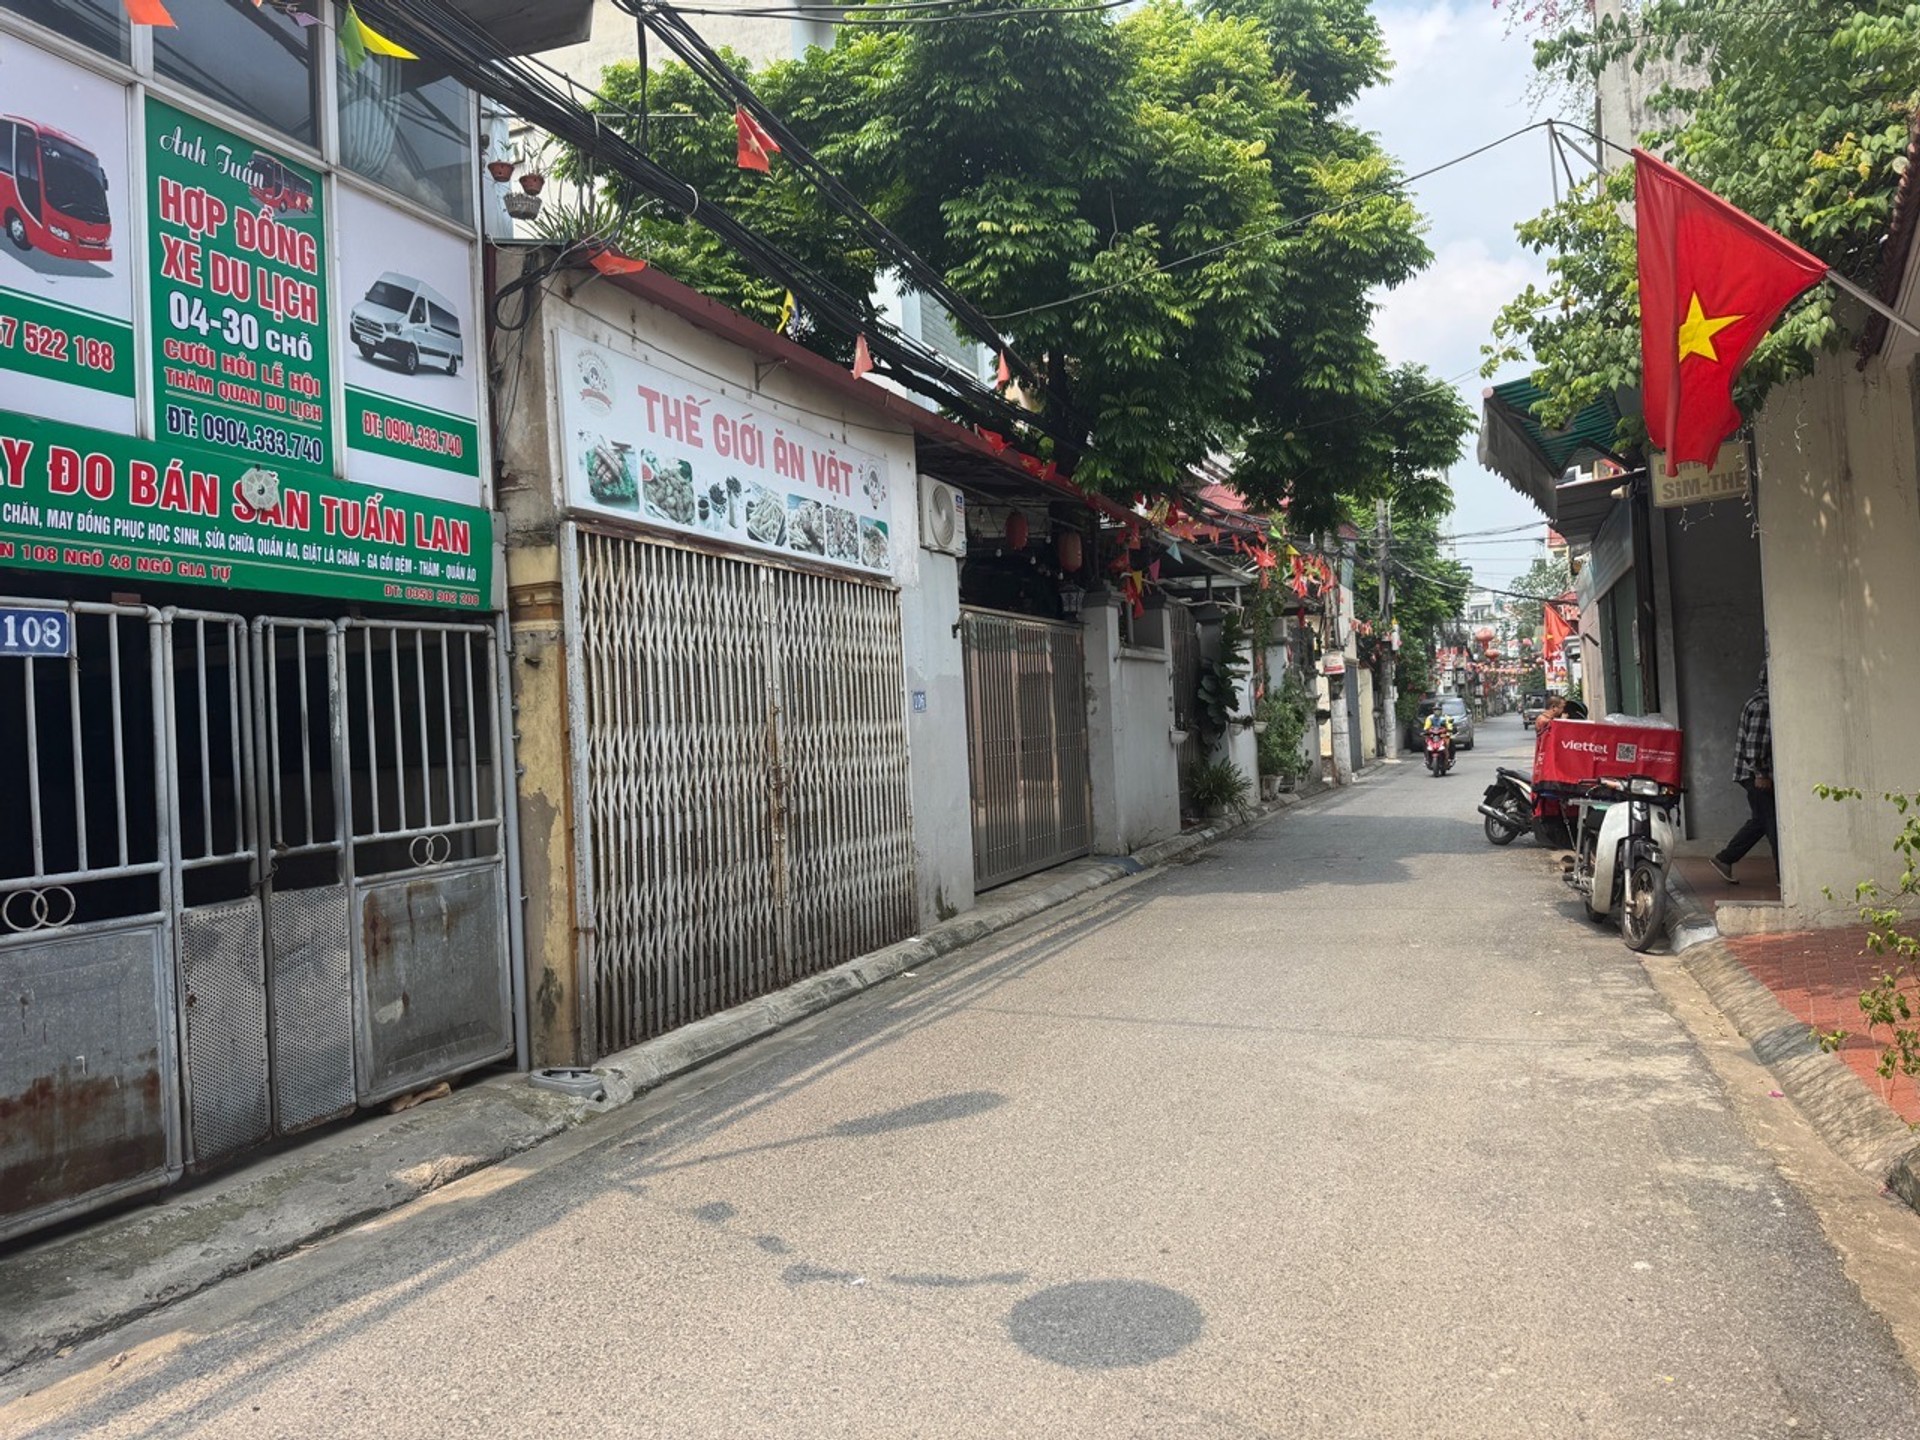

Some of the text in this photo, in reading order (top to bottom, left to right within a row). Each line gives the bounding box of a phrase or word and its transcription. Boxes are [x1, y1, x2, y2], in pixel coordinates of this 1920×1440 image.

[159, 126, 208, 166] Anh
[158, 175, 318, 276] HỢP ĐỒNG
[159, 232, 319, 324] XE DU LỊCH
[0, 315, 115, 373] 7 522 188
[169, 291, 313, 362] 04-30 CHỖ
[221, 352, 256, 380] HỎI
[262, 361, 284, 388] LỄ
[289, 371, 321, 399] HỘI
[218, 381, 262, 408] QUAN
[265, 392, 287, 413] DU
[290, 400, 323, 423] LỊCH
[166, 404, 324, 465] ĐT: 0904.333.740
[362, 410, 463, 459] ĐT: 0904.333.740
[637, 384, 854, 500] THẾ GIỚI ĂN VẬT
[0, 438, 33, 488] Y
[47, 445, 115, 502] ĐO
[129, 458, 220, 518] BÁN
[320, 493, 406, 546] TUẤN
[414, 512, 471, 556] LAN
[3, 501, 43, 528] CHĂN,
[47, 508, 74, 531] MAY
[114, 518, 145, 543] PHỤC
[148, 522, 170, 546] HỌC
[173, 526, 202, 549] SINH,
[21, 544, 58, 563] 108
[109, 554, 131, 570] 48
[136, 557, 173, 575] NGÔ
[178, 562, 206, 578] GIA
[211, 564, 232, 583] TỰ
[4, 614, 61, 648] 108
[1561, 740, 1608, 754] viettel
